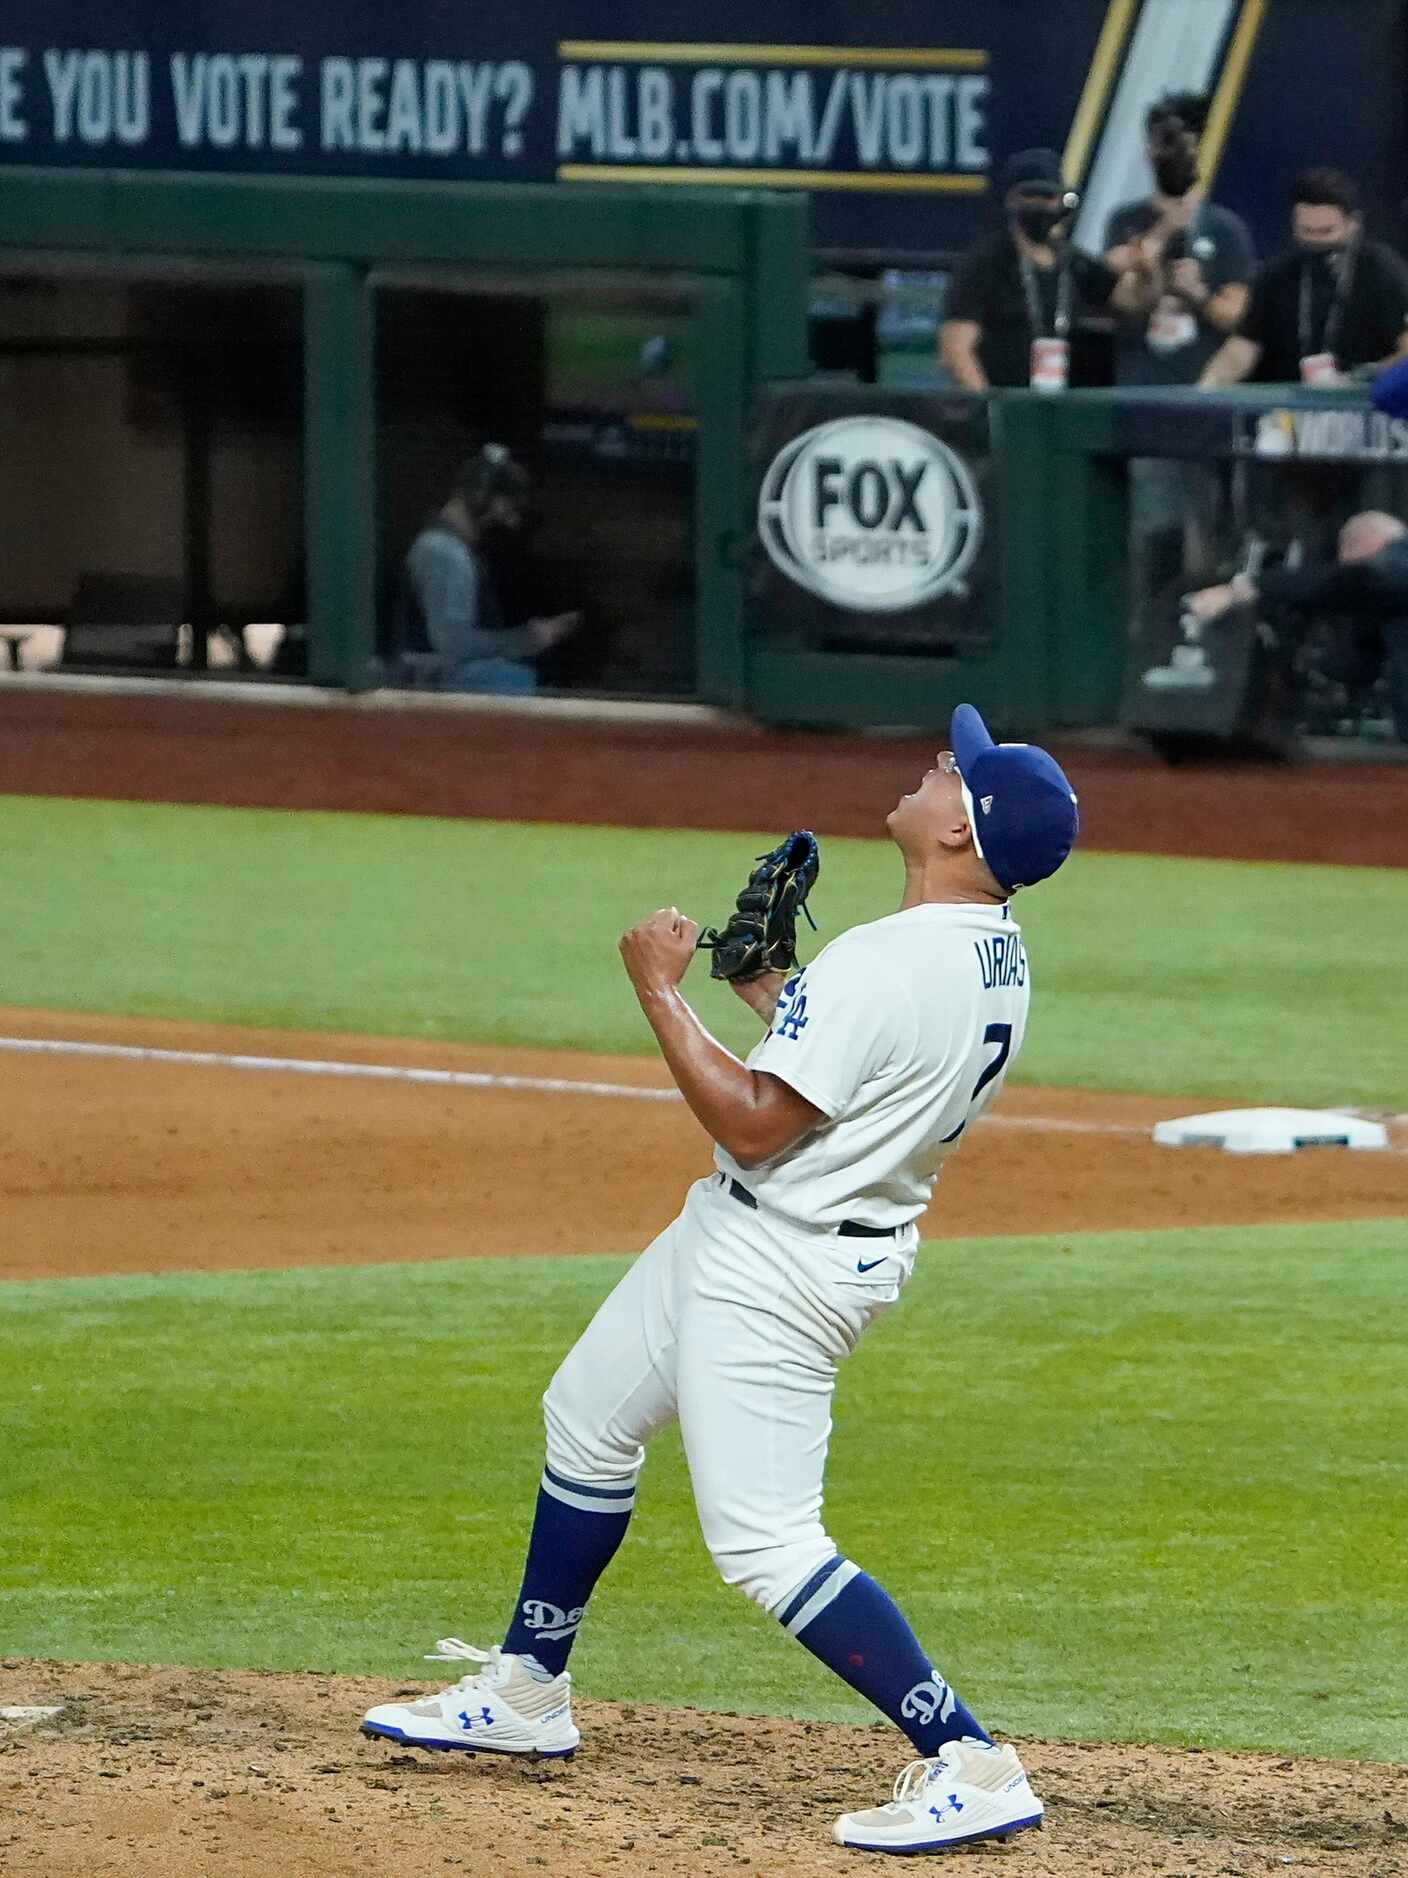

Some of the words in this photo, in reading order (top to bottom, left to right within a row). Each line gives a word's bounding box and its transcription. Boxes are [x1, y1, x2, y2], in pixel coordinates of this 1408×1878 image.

[44, 50, 150, 144] YOU
[170, 54, 304, 150] VOTE
[320, 59, 533, 156] READY?
[557, 64, 990, 169] MLB.COM/VOTE
[813, 453, 929, 533] FOX
[939, 1022, 1013, 1144] 7
